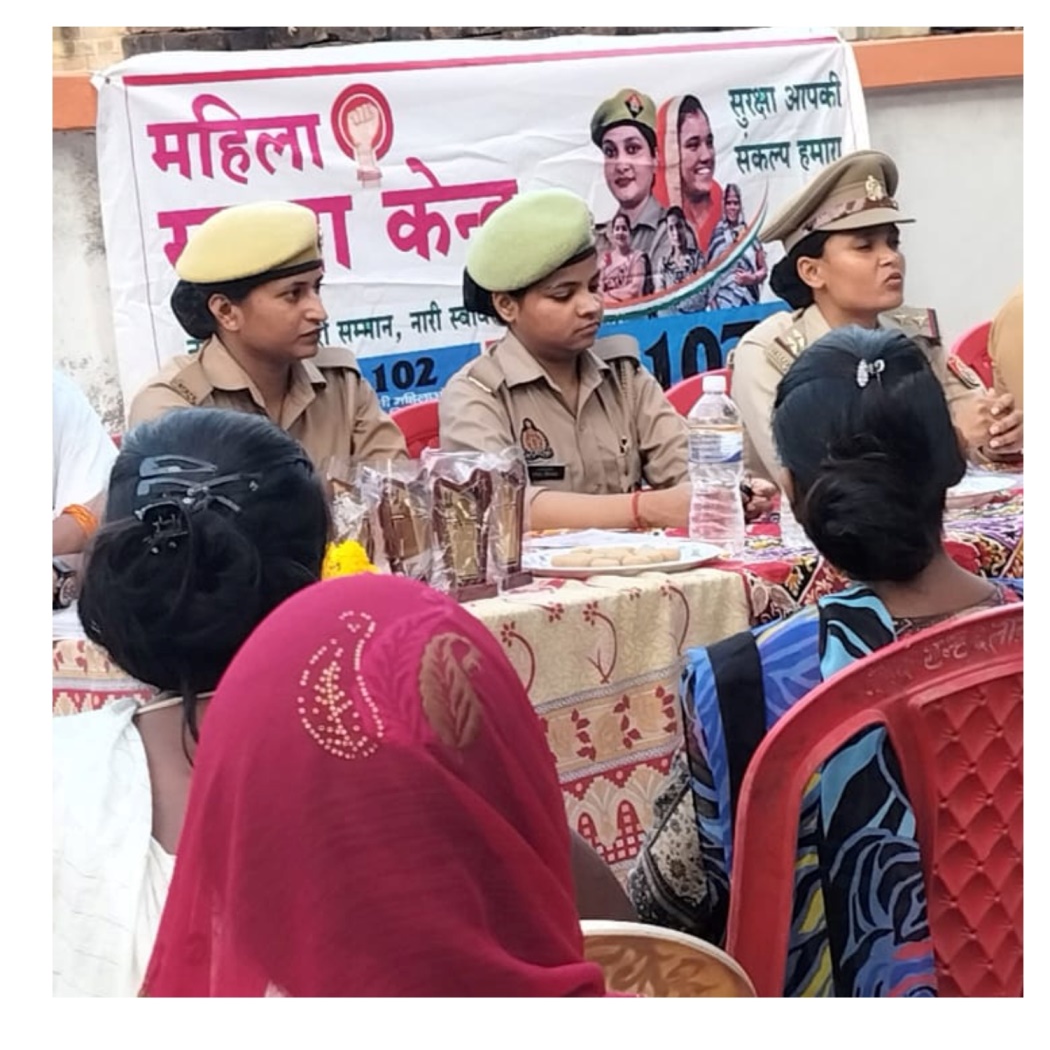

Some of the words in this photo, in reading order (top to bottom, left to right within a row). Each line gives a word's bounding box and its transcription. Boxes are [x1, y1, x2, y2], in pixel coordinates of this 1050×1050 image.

[728, 86, 777, 129] सुरक्षा
[784, 71, 842, 112] आपकी
[146, 93, 324, 185] महिला
[734, 132, 791, 174] संकल्प
[797, 137, 842, 171] हमारा
[336, 314, 402, 343] सम्मान,
[410, 301, 441, 334] नारी
[371, 357, 438, 393] 102
